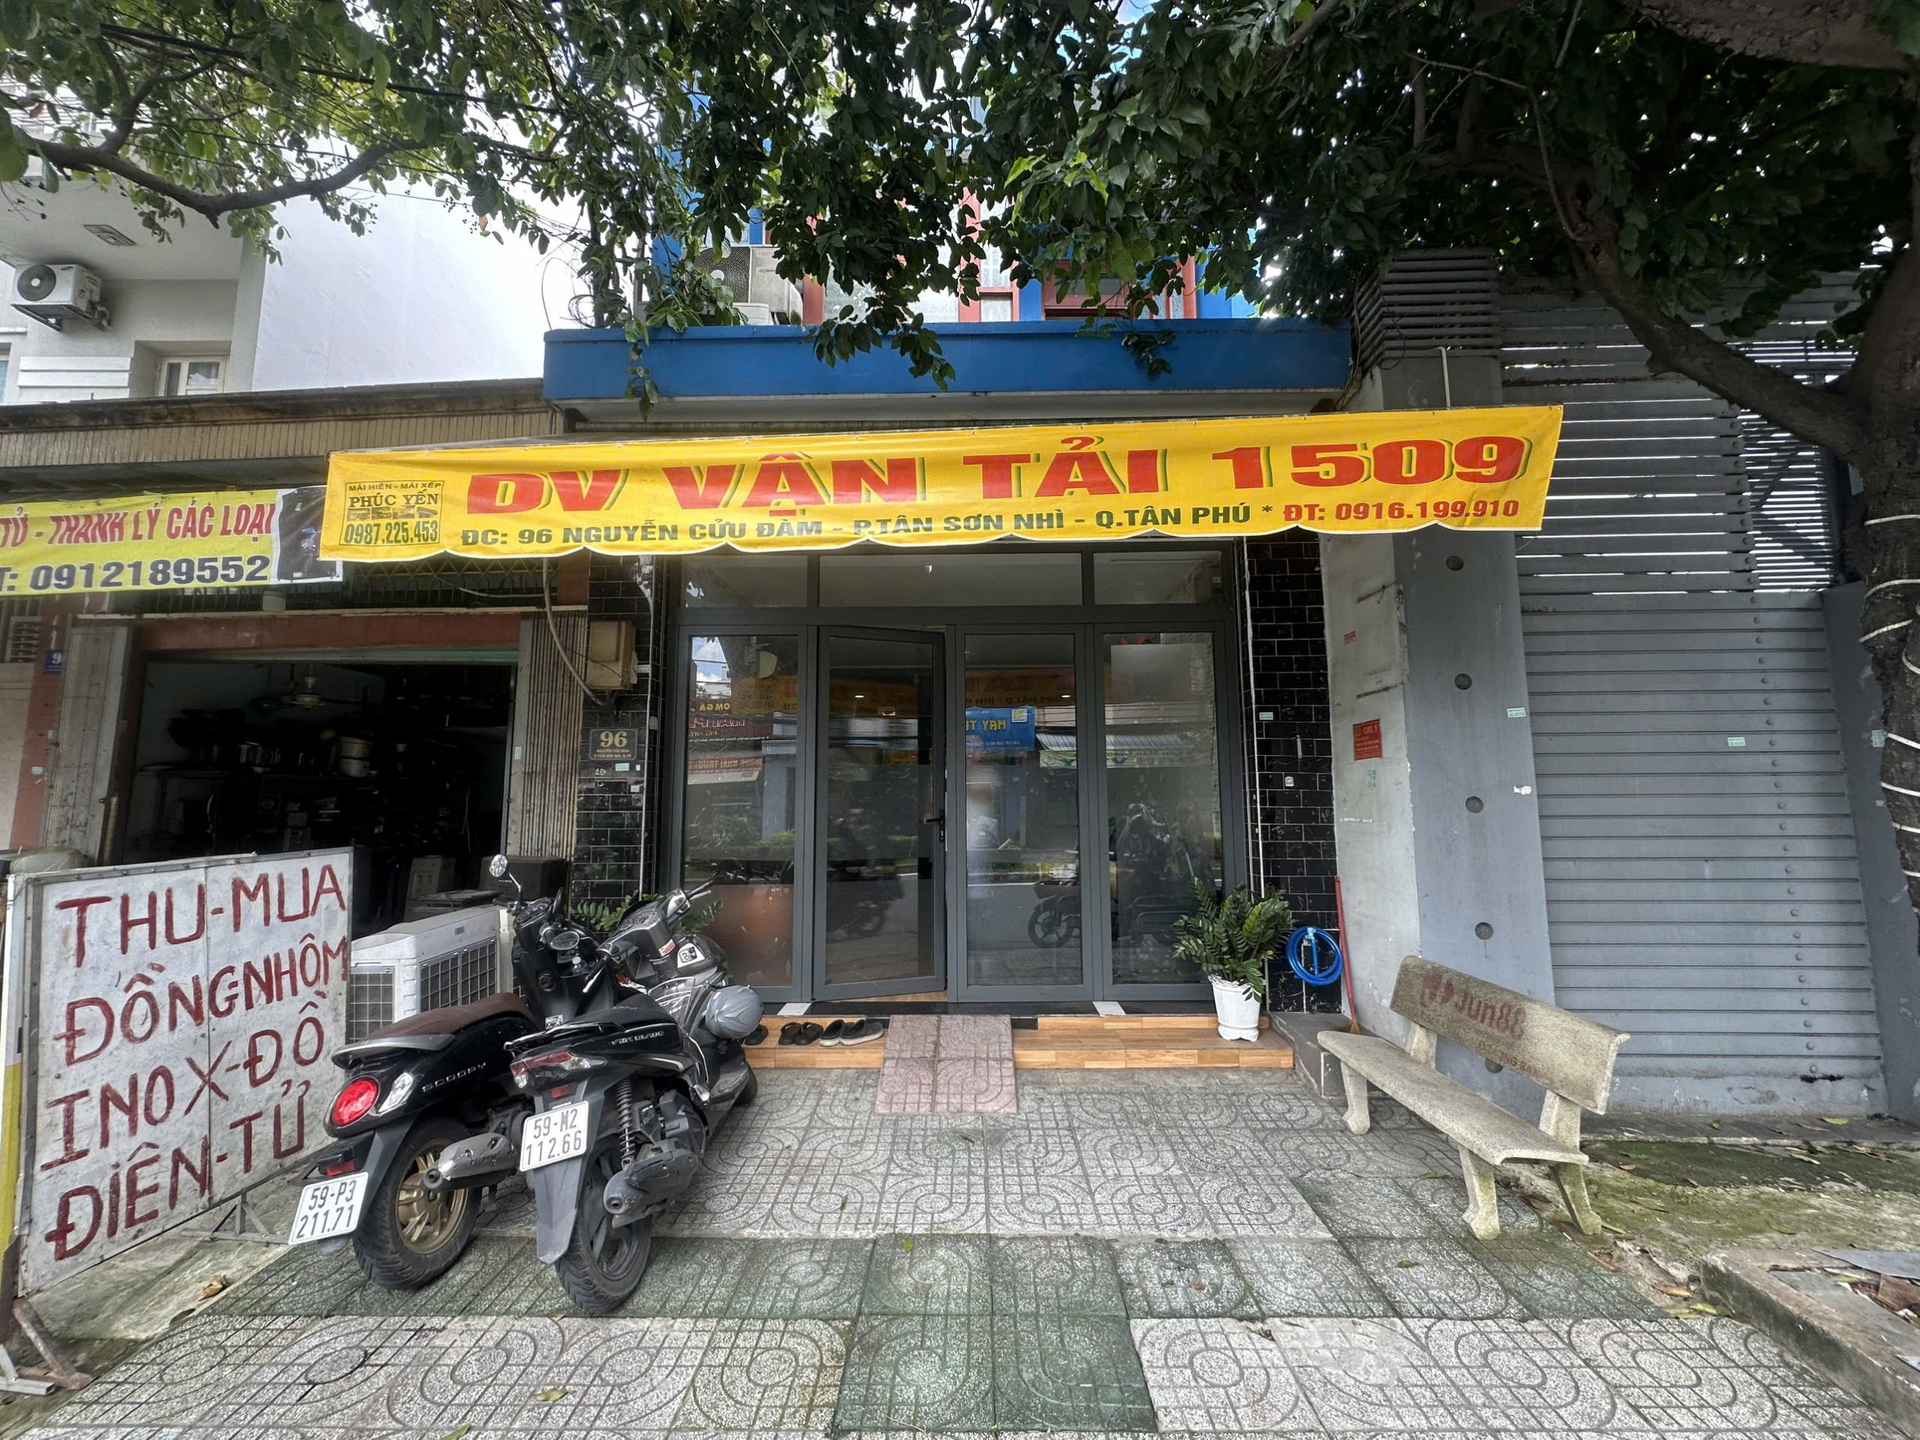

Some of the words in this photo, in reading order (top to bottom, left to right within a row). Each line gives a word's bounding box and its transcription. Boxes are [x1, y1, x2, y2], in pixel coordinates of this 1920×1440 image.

[349, 484, 366, 492] MÁI
[400, 482, 418, 490] MÁI
[467, 468, 630, 515] DV
[661, 450, 927, 517] VẬN
[962, 436, 1168, 500] TẢI
[1211, 435, 1534, 490] 1509
[349, 492, 397, 508] PHÚC
[402, 489, 439, 505] YẾN
[1283, 503, 1326, 522] ĐT:
[1335, 499, 1520, 521] 0916.199.910
[0, 506, 29, 548] TỬ
[47, 511, 129, 545] THANH
[131, 501, 162, 541] LÝ
[166, 499, 215, 540] CÁC
[219, 502, 276, 542] LOẠI
[343, 520, 439, 545] 0987.225.453
[461, 529, 508, 546] ĐC:
[518, 528, 552, 544] 96
[562, 519, 678, 543] NGUYỄN
[688, 518, 747, 541] CỬU
[755, 518, 822, 538] ĐÀM
[853, 514, 933, 536] P.TÂN
[943, 513, 1003, 532] SƠN
[1013, 509, 1064, 531] NHÌ
[1095, 505, 1181, 528] Q.TÂN
[1191, 501, 1251, 524] PHÚ
[29, 555, 271, 590] 0912189552
[600, 731, 628, 748] 96
[55, 864, 347, 968] THU-MUA
[40, 990, 325, 1172] INOX-ĐỒ
[526, 1129, 582, 1166] 112.66
[45, 1079, 311, 1261] ĐIỆN-TỬ
[308, 1179, 357, 1211] 59-P3
[296, 1203, 354, 1240] 211.71
